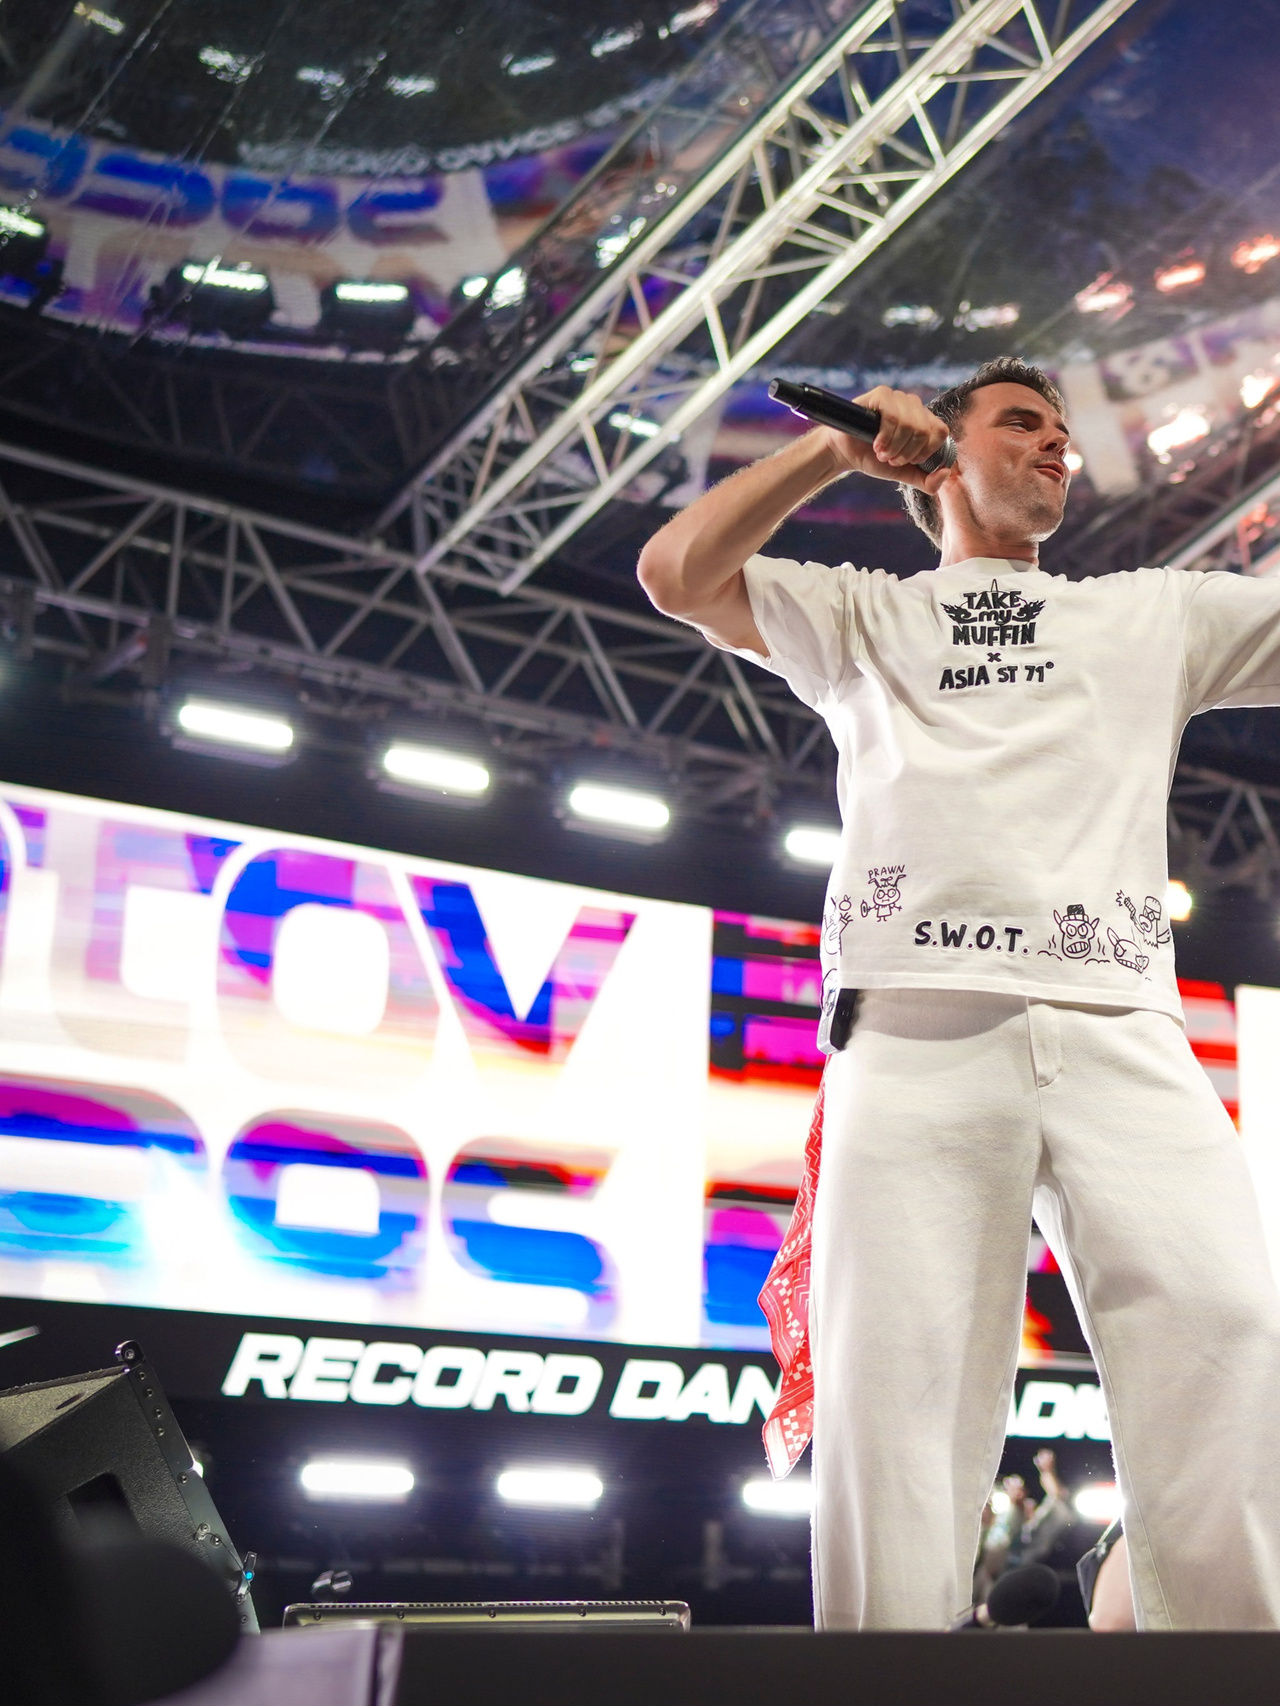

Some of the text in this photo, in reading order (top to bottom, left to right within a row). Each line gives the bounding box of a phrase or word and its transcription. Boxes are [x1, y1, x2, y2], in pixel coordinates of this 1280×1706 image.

[963, 591, 1022, 609] TAKE
[979, 609, 1012, 625] my
[952, 622, 1036, 646] MUFFIN
[939, 665, 990, 690] ASIA
[997, 665, 1018, 683] ST
[868, 864, 905, 879] PRAWN
[0, 797, 638, 1093] TOV
[914, 920, 1029, 953] S.W.O.T.
[221, 1331, 604, 1416] RECORD
